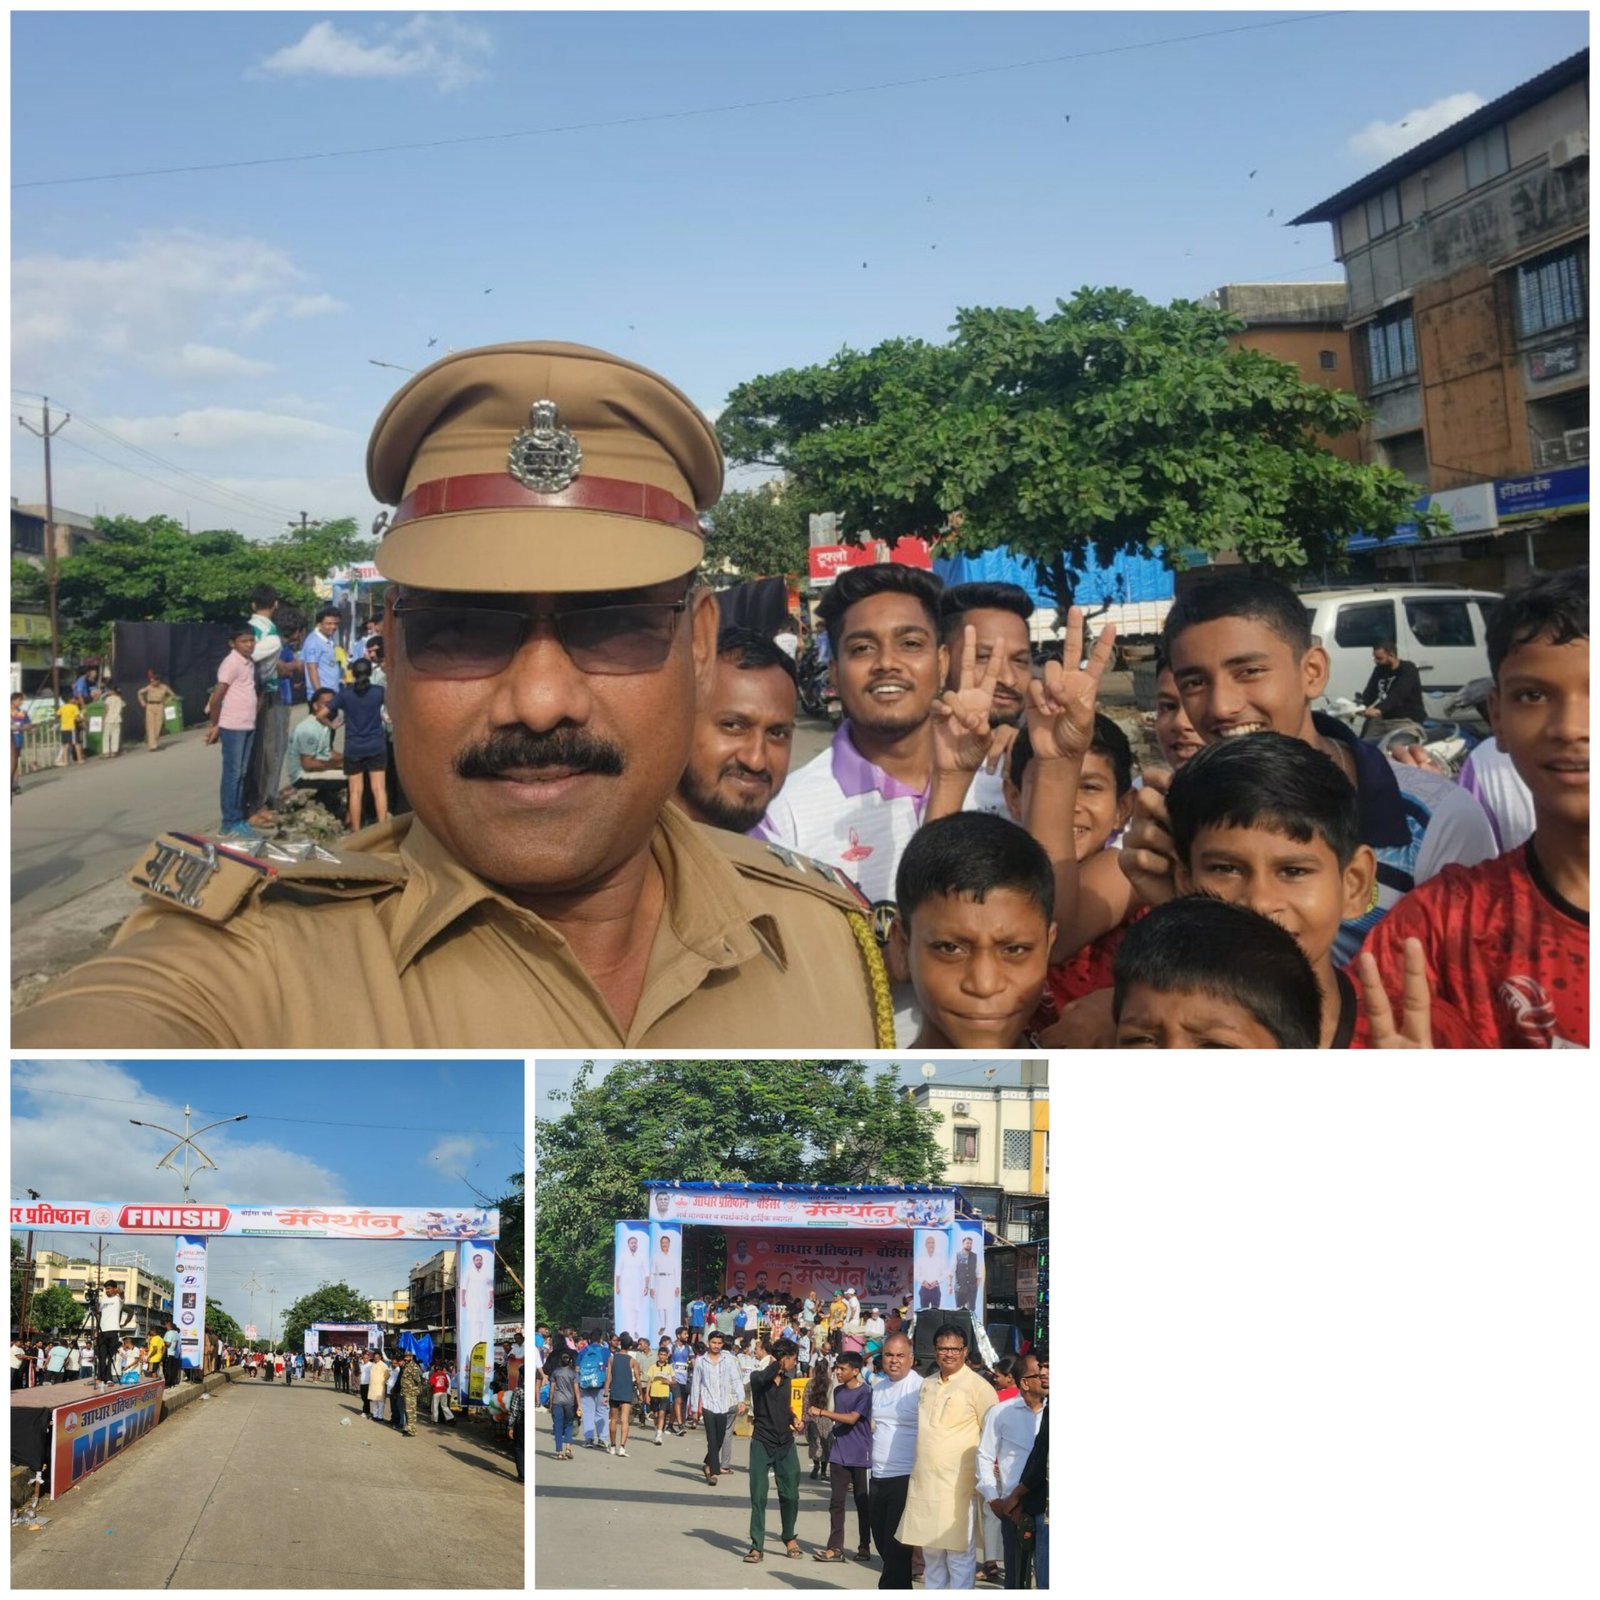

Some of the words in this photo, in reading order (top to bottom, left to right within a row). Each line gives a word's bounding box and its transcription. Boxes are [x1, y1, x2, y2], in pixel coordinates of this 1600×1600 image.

[692, 1195, 717, 1208] आधार
[718, 1193, 749, 1209] प्रतिष्ठान
[26, 1203, 91, 1225] प्रतिष्ठान
[127, 1209, 221, 1228] FINISH
[774, 1243, 812, 1256] आधार
[815, 1241, 864, 1257] प्रतिष्ठान
[80, 1405, 111, 1427] आधार
[111, 1396, 137, 1416] प्रतिष्ठान
[71, 1403, 156, 1482] MEDIA
